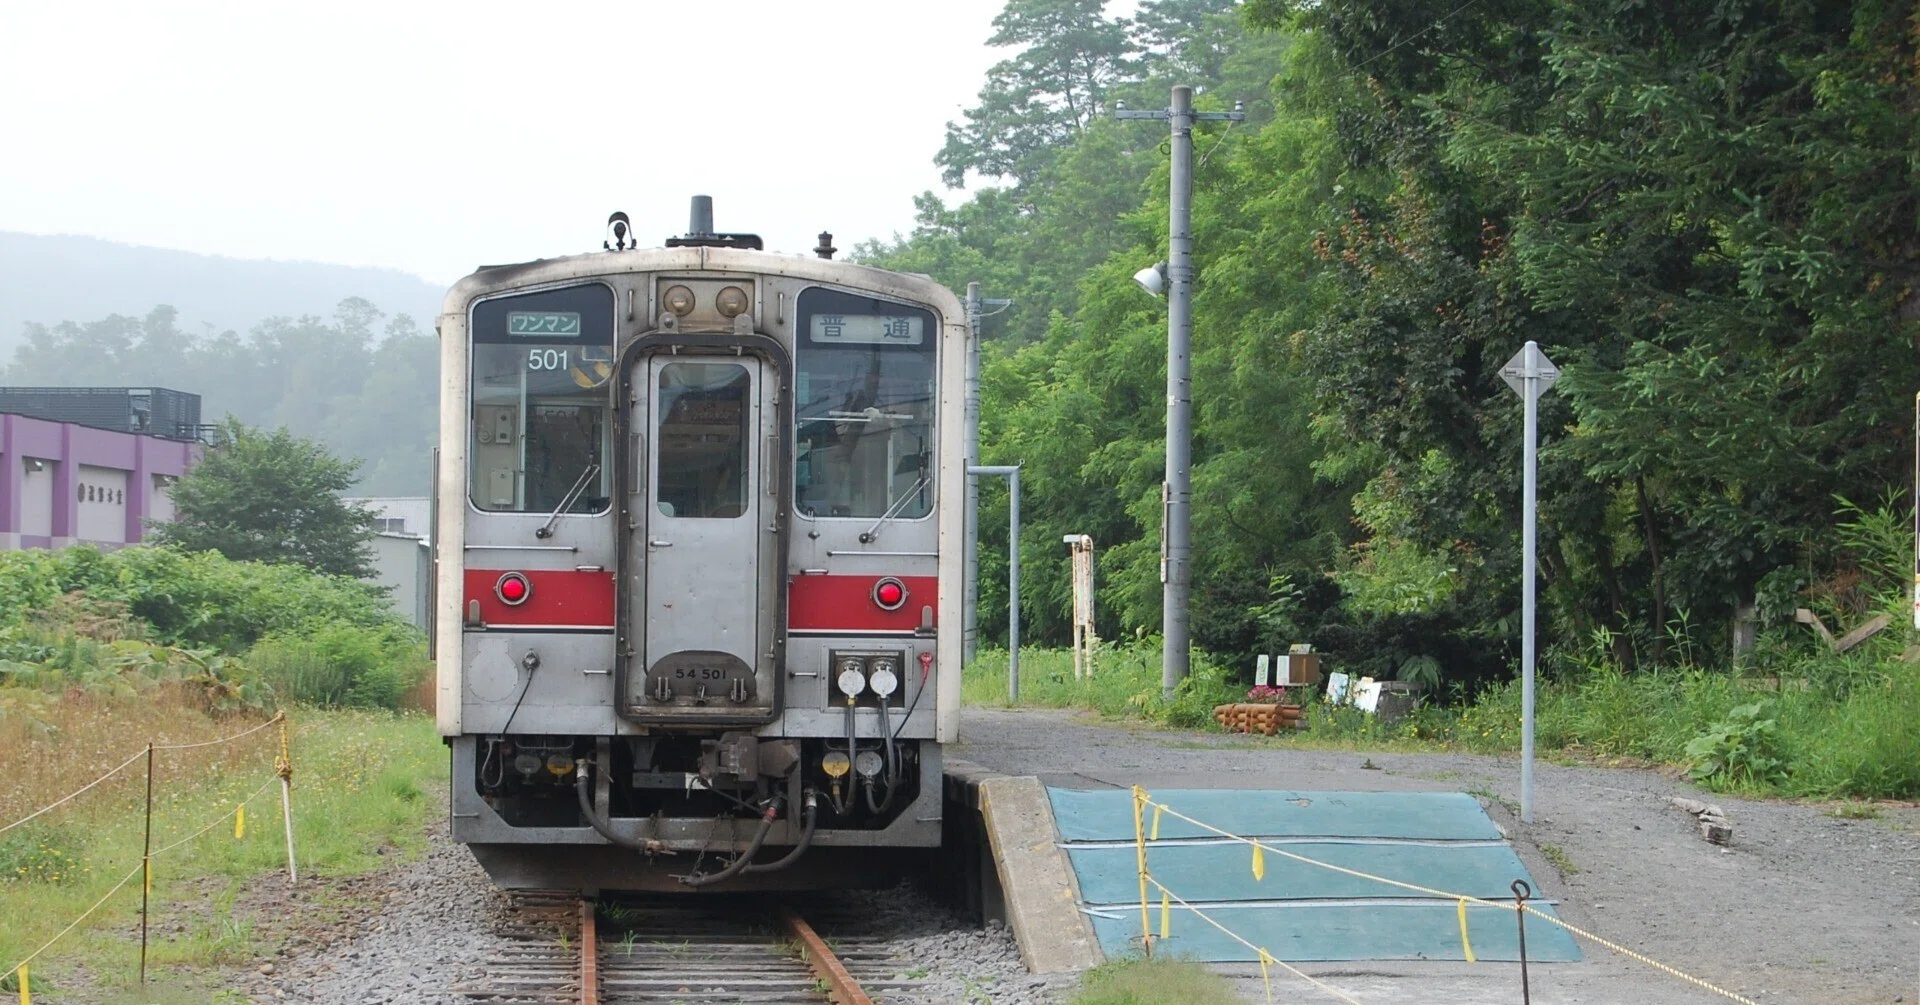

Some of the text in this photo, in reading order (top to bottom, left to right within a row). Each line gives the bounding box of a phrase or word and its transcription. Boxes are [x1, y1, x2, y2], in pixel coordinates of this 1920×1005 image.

[512, 315, 576, 332] ワンマン
[819, 315, 911, 339] 普通
[528, 349, 567, 370] 501
[675, 668, 726, 680] 54 501
